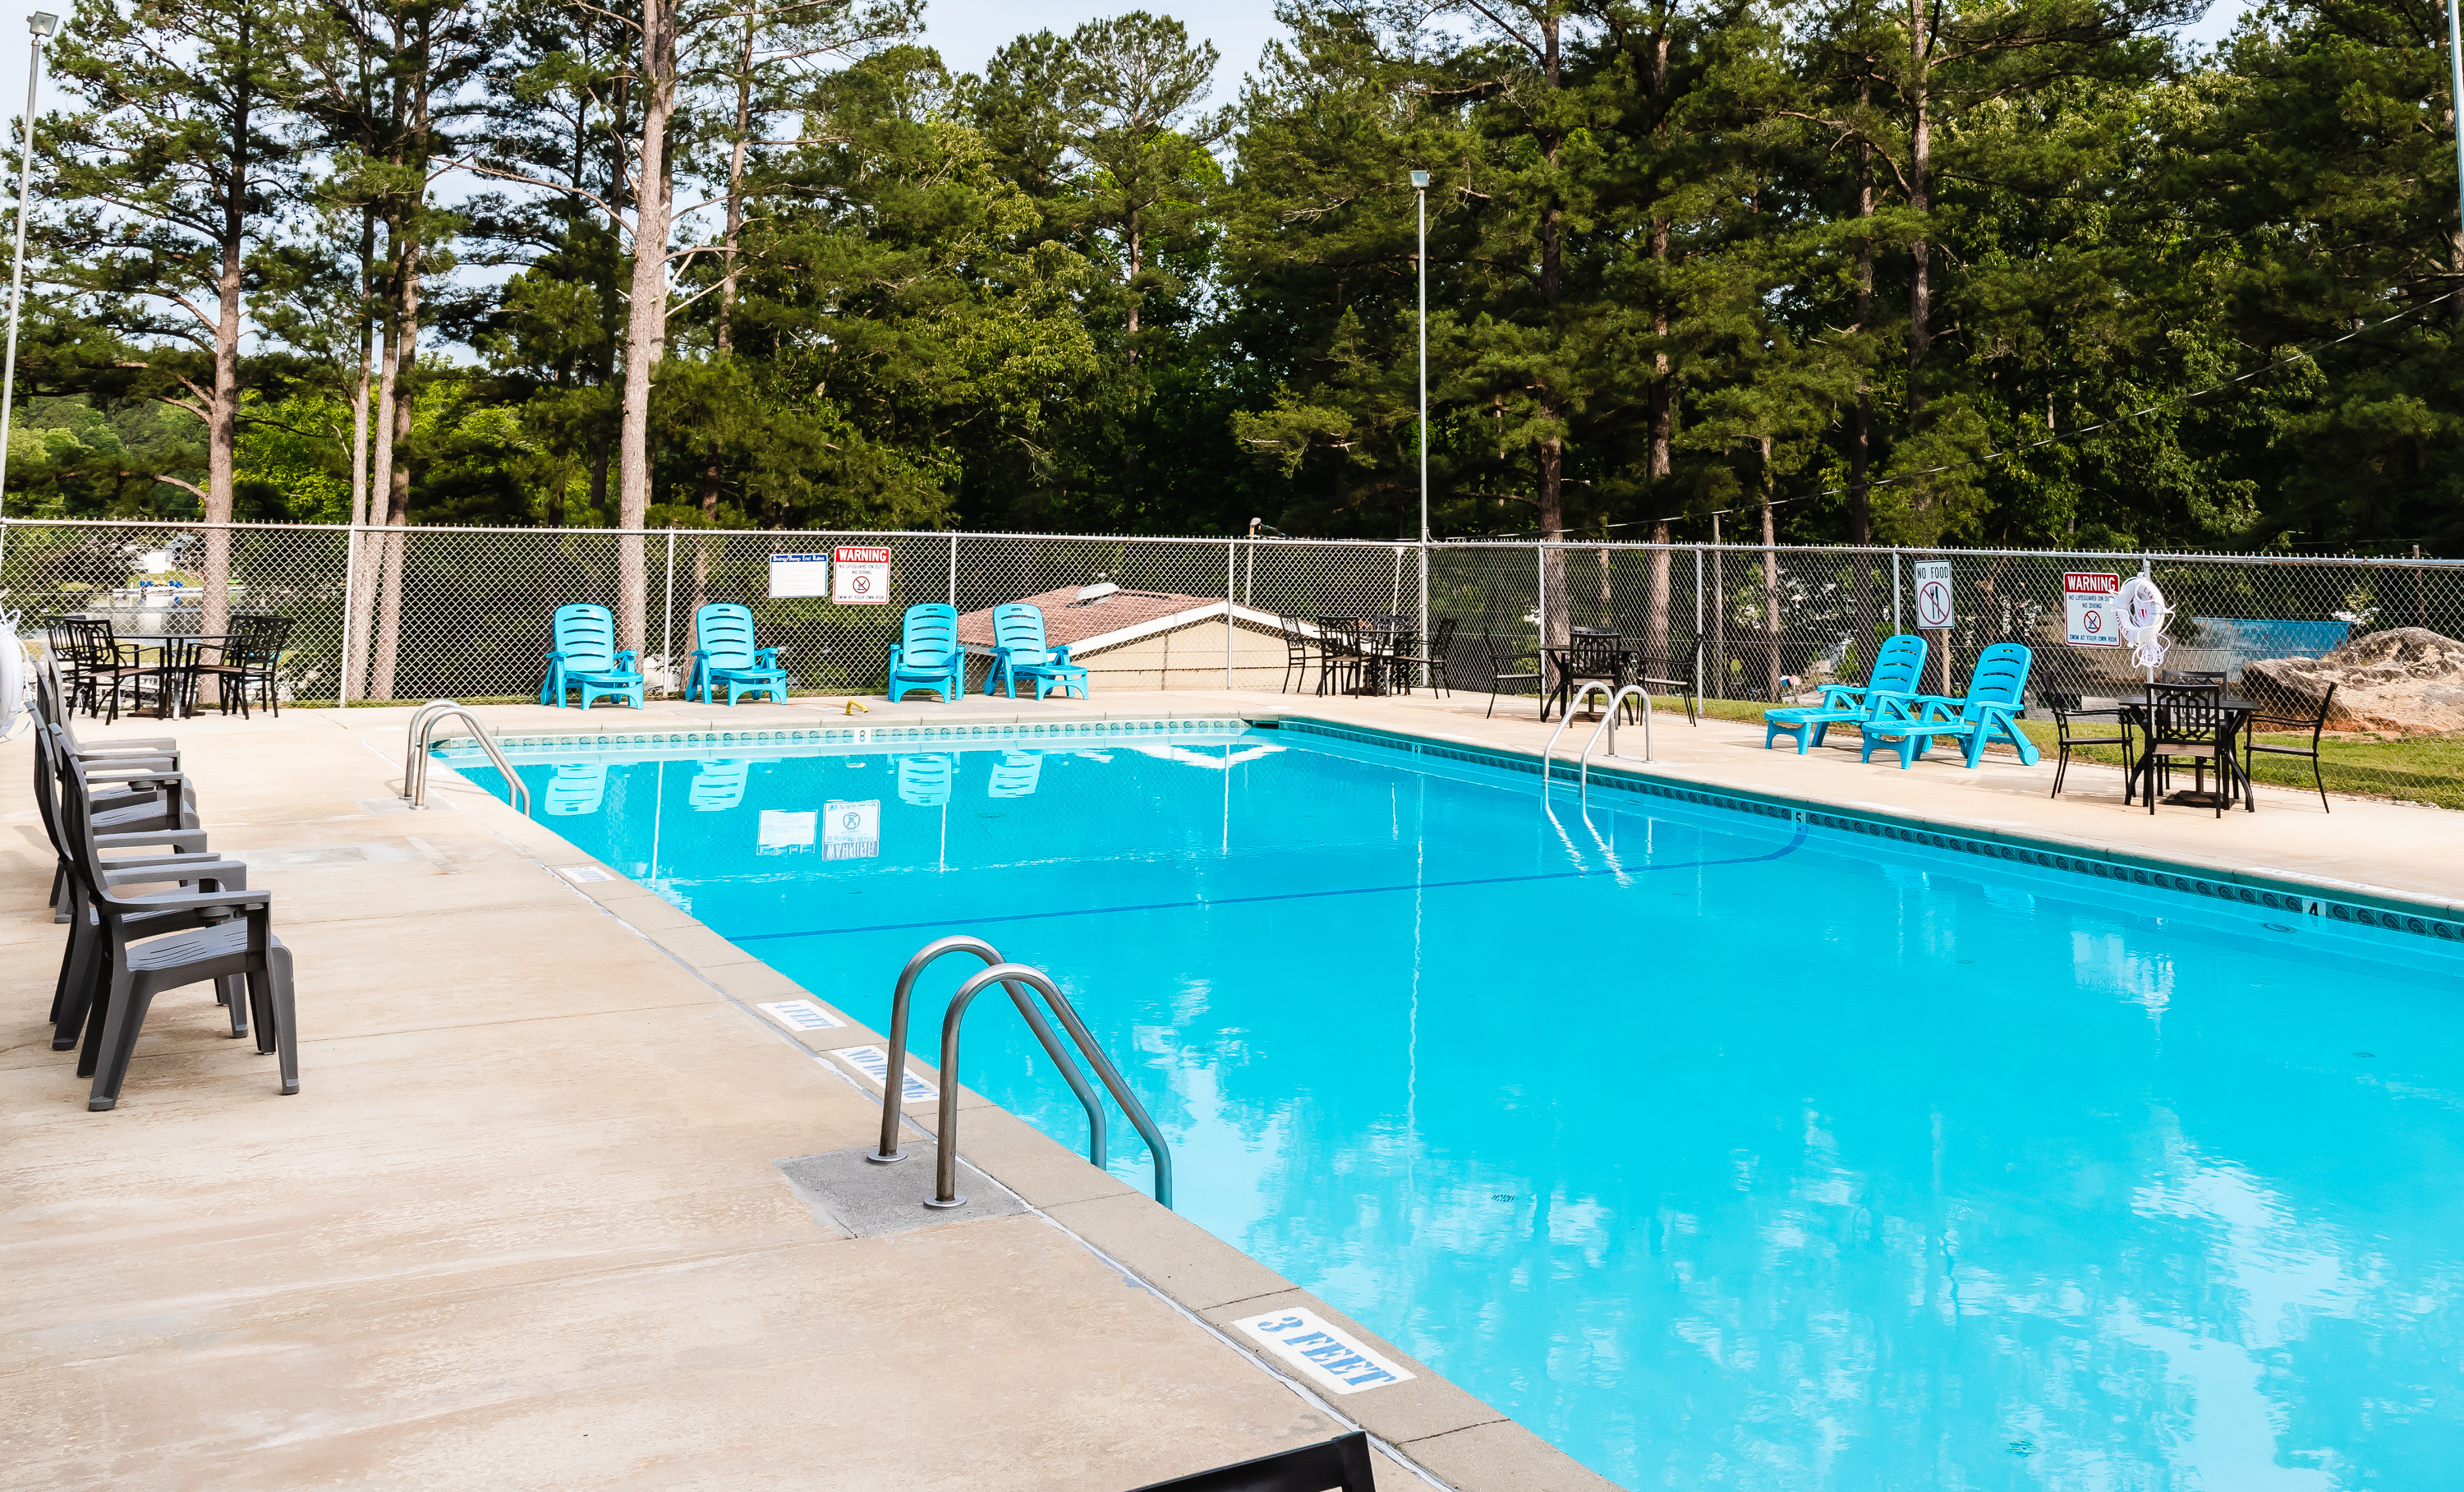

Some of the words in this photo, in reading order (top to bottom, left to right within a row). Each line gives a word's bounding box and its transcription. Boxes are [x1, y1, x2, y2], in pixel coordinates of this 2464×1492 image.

[839, 549, 887, 562] WARNING
[1917, 567, 1926, 579] NO
[1931, 566, 1948, 578] FOOD
[2067, 575, 2116, 592] WARNING
[2308, 901, 2319, 916] 4
[782, 1008, 836, 1029] FEET
[841, 1048, 884, 1062] NO
[1257, 1316, 1304, 1333] 3
[1282, 1331, 1397, 1386] FEET
